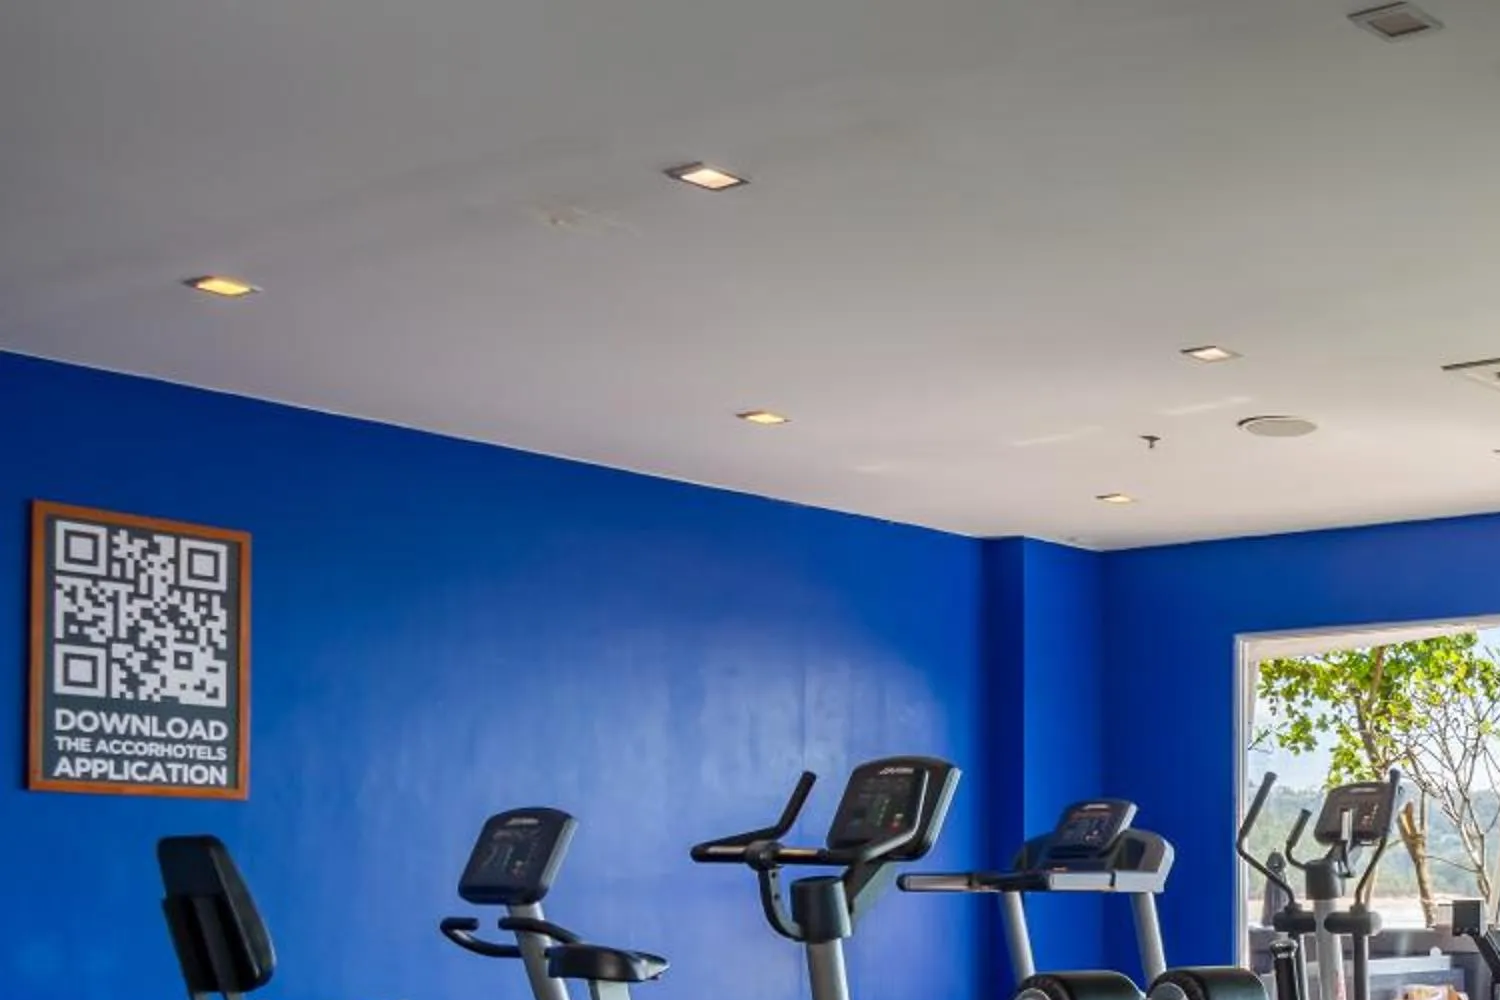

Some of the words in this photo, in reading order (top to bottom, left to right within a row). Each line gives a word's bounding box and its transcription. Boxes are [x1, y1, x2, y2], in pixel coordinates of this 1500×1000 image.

[54, 708, 228, 741] DOWNLOAD
[55, 735, 91, 752] THE
[95, 739, 227, 761] ACCORHOTELS
[53, 756, 227, 785] APPLICATION
